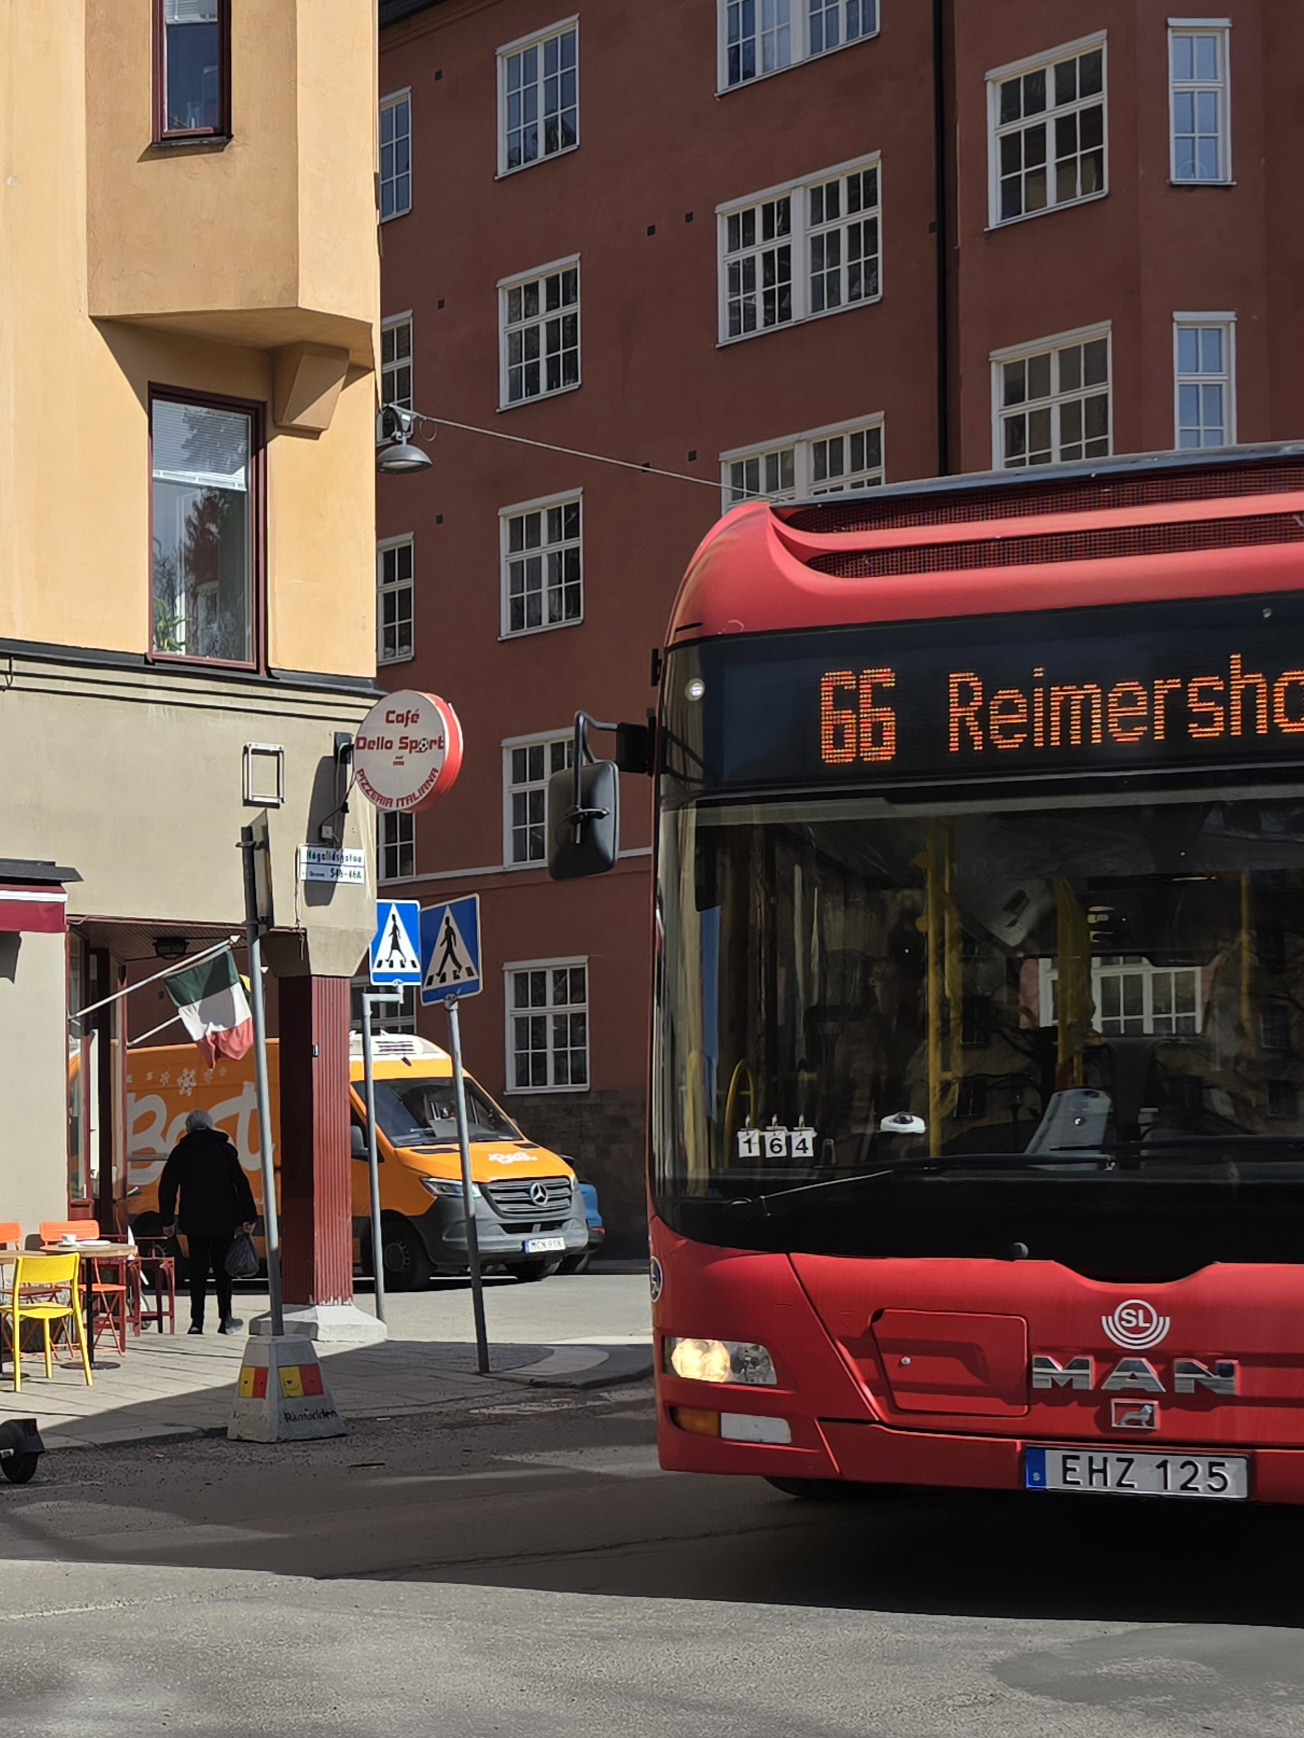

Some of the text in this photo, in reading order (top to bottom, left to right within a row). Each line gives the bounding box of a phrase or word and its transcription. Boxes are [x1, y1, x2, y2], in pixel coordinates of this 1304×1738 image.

[385, 708, 420, 728] Café
[820, 667, 896, 763] 66
[356, 736, 394, 750] Dello
[356, 767, 439, 808] PIZZERIA ITALIANA
[1120, 1308, 1151, 1328] SL
[1032, 1355, 1241, 1396] MAN
[1062, 1454, 1139, 1489] EHZ
[1155, 1459, 1229, 1493] 125
